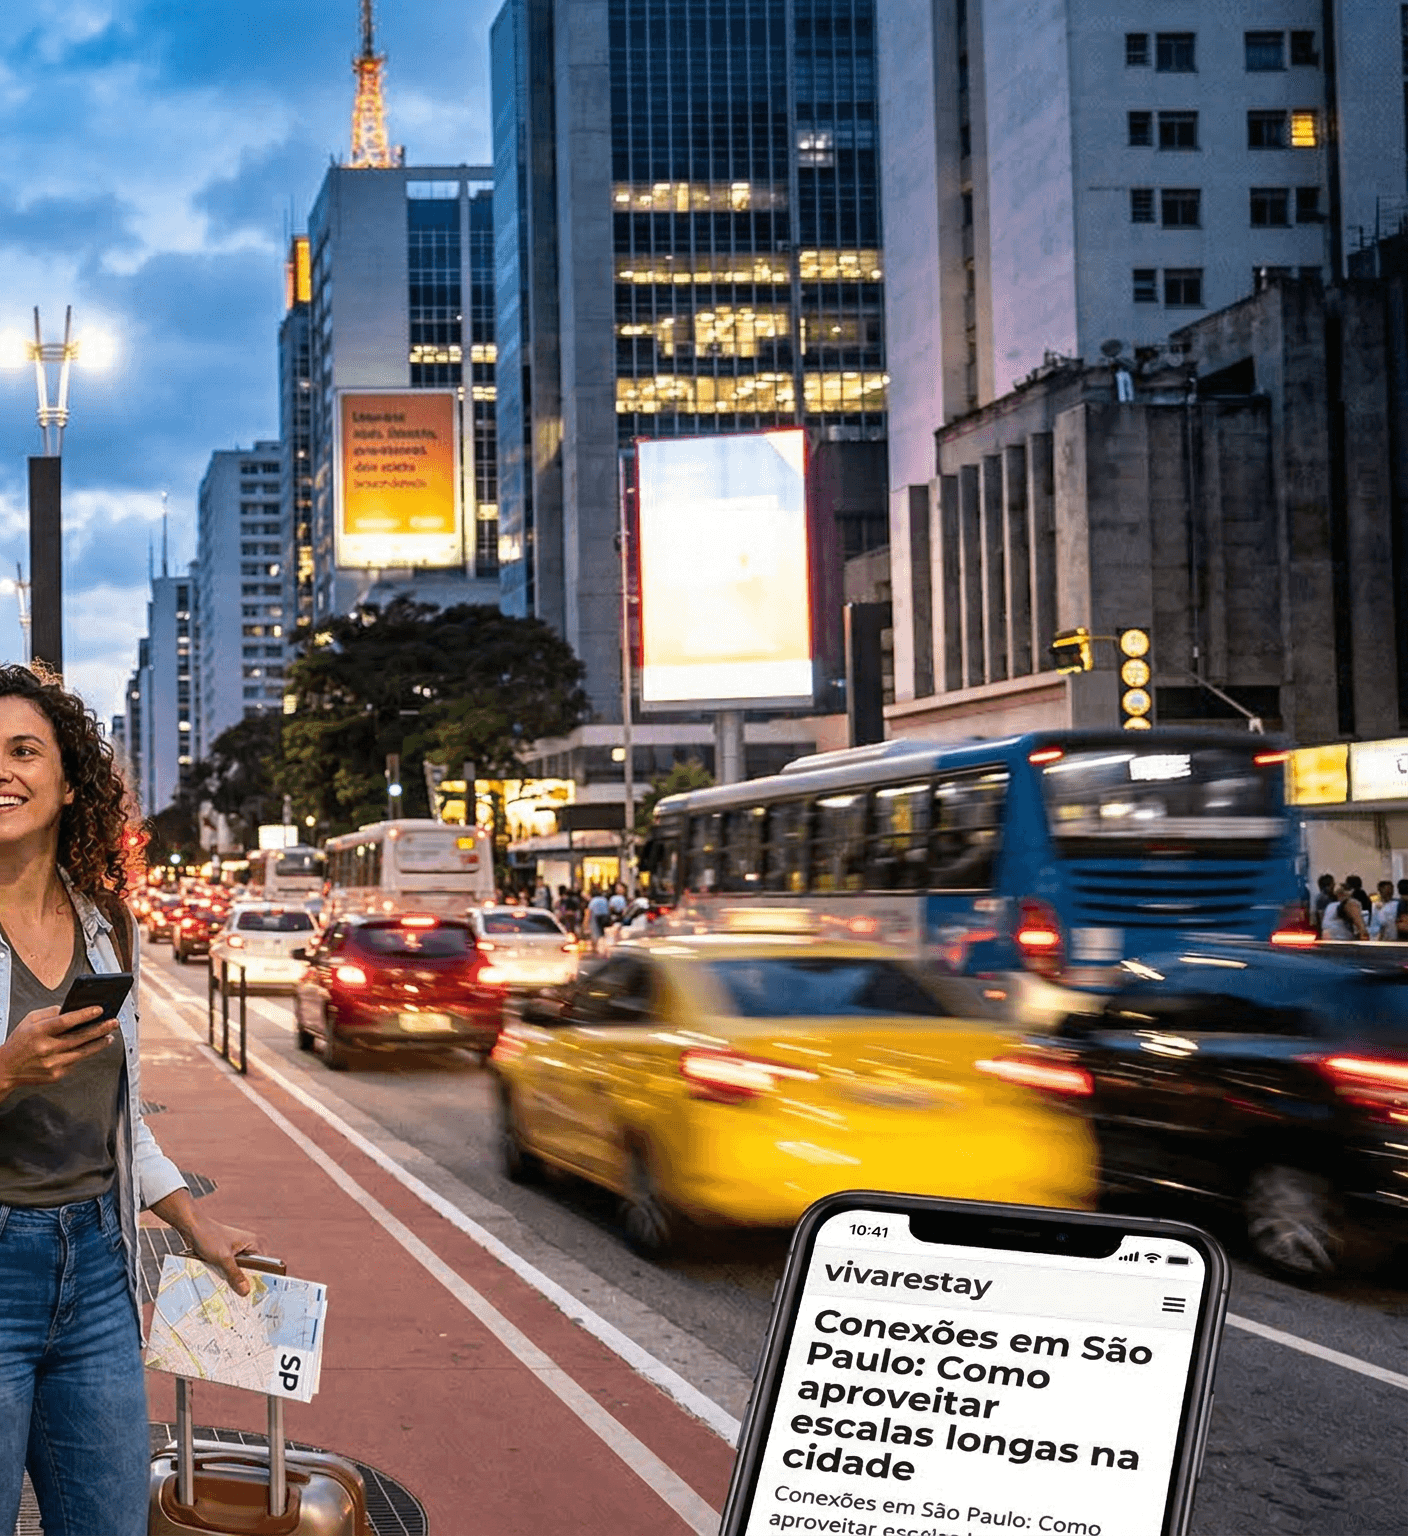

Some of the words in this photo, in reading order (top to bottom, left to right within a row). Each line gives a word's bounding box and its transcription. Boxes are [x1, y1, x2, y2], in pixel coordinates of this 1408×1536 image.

[849, 1224, 889, 1238] 10:41
[825, 1260, 993, 1301] vivarestay
[814, 1309, 999, 1350] Conexões
[1009, 1333, 1070, 1358] em
[1080, 1335, 1153, 1365] São
[278, 1354, 301, 1391] SP
[806, 1341, 926, 1377] Paulo:
[937, 1355, 1051, 1389] Como
[797, 1378, 1000, 1419] aproveitar
[782, 1442, 915, 1481] cidade
[790, 1414, 934, 1448] escalas
[945, 1423, 1079, 1465] longas
[1090, 1446, 1140, 1471] na
[769, 1513, 878, 1536] aproveitar
[774, 1485, 877, 1512] Conexões
[882, 1500, 915, 1516] em
[967, 1506, 1032, 1529] Paulo:
[1038, 1515, 1102, 1536] Como
